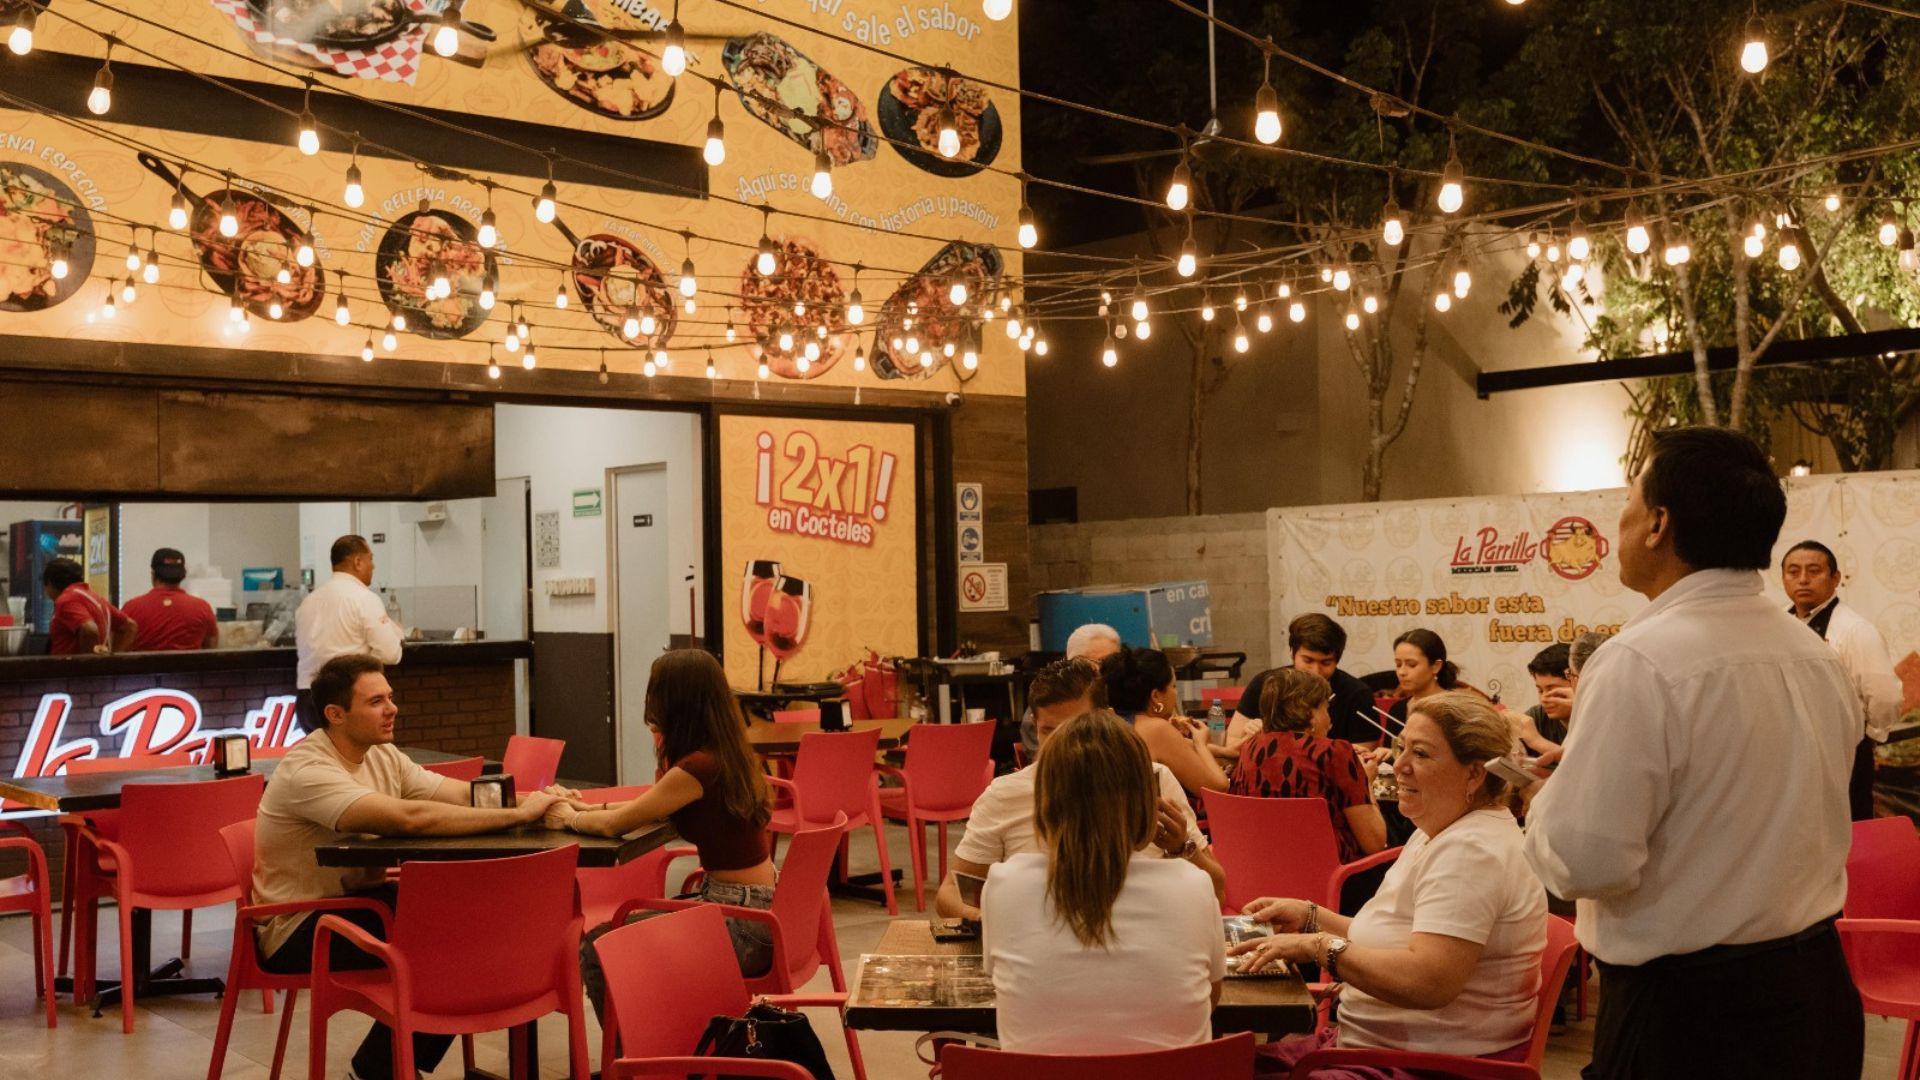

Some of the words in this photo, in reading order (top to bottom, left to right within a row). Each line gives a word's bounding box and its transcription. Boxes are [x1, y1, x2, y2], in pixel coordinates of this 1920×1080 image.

[843, 10, 891, 44] sale
[896, 6, 915, 38] el
[917, 3, 981, 41] sabor
[383, 188, 446, 215] RELLENA
[780, 172, 798, 190] se
[880, 194, 936, 231] historia
[937, 195, 949, 218] y
[769, 507, 793, 530] en
[796, 505, 873, 545] Cocteles
[1450, 535, 1475, 565] La
[1476, 526, 1538, 564] Parrilla
[1166, 588, 1186, 603] en
[1425, 592, 1490, 615] sabor
[1494, 593, 1546, 613] esta
[1489, 617, 1553, 643] fuera
